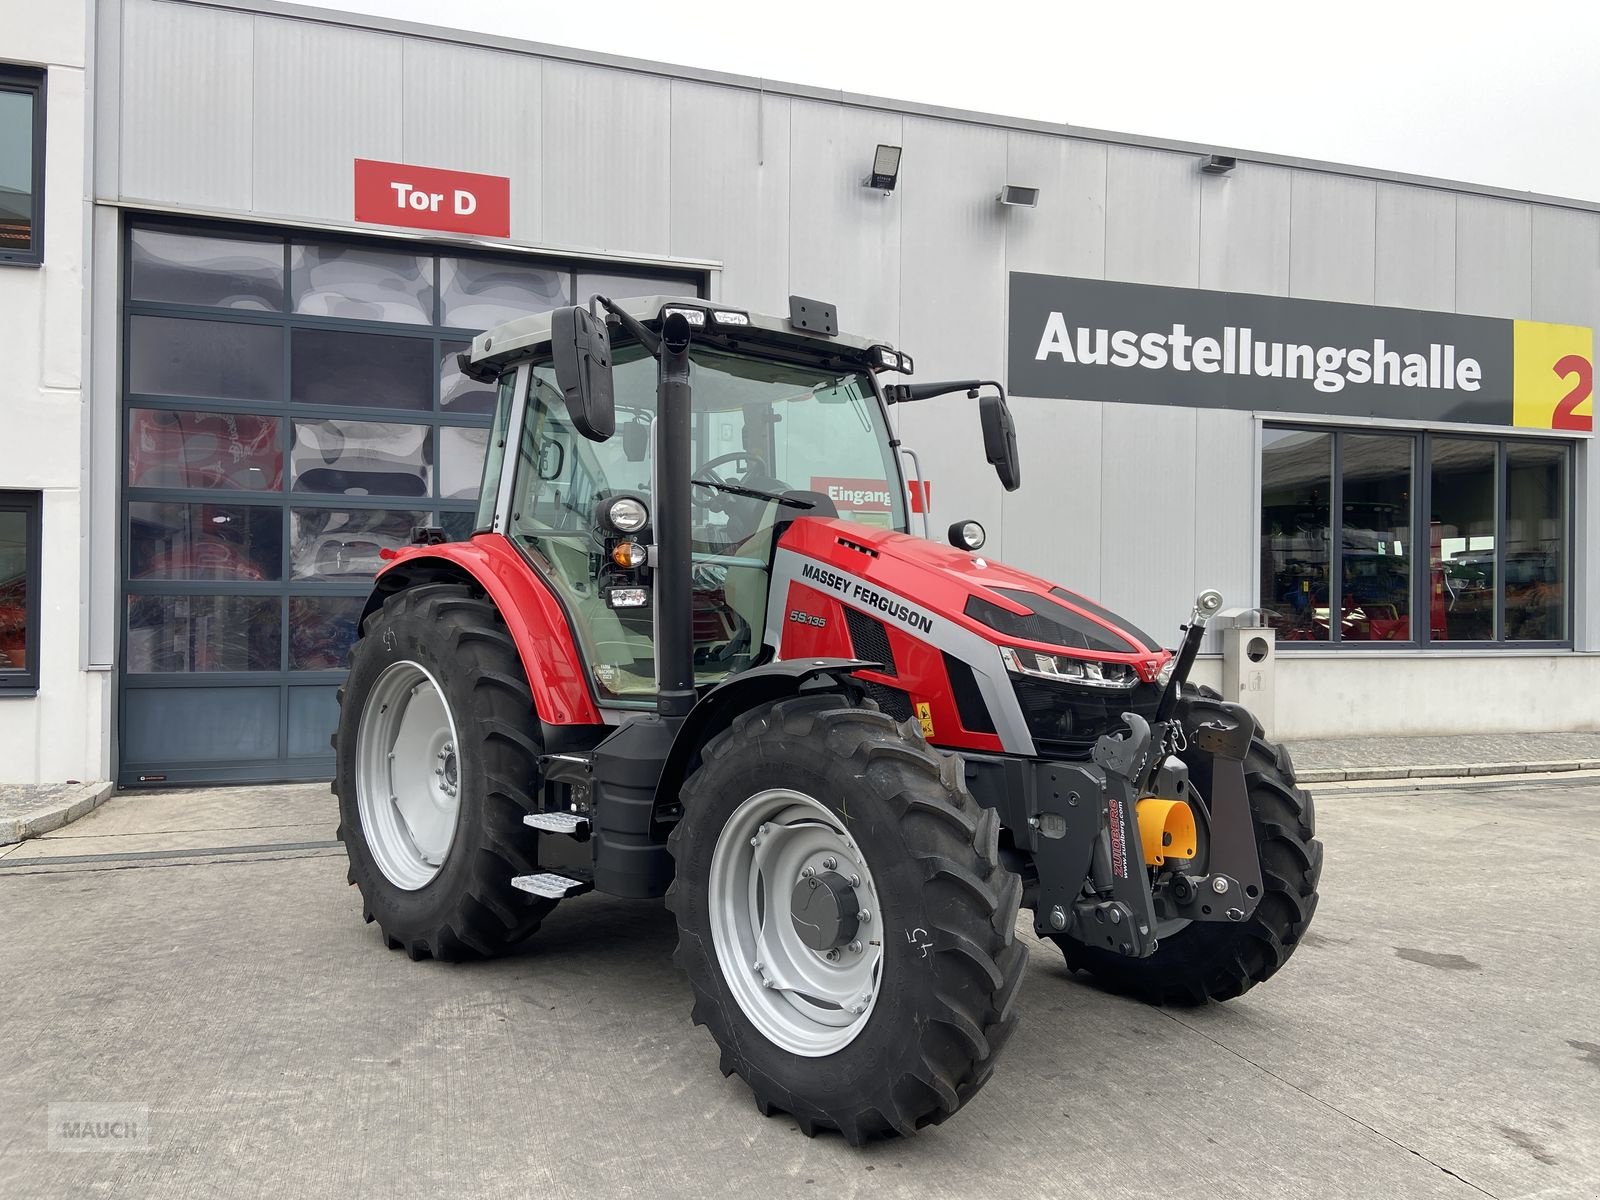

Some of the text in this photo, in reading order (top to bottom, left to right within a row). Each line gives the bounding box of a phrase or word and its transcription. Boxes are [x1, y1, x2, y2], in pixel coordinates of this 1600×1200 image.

[391, 182, 477, 215] Tor D
[1034, 311, 1592, 432] Ausstellungshalle 2
[789, 610, 827, 628] 5S.135
[802, 563, 933, 634] MASSEY FERGUSON
[1109, 799, 1123, 877] ZUIDBERG
[1118, 801, 1128, 878] www.zuidberg.com
